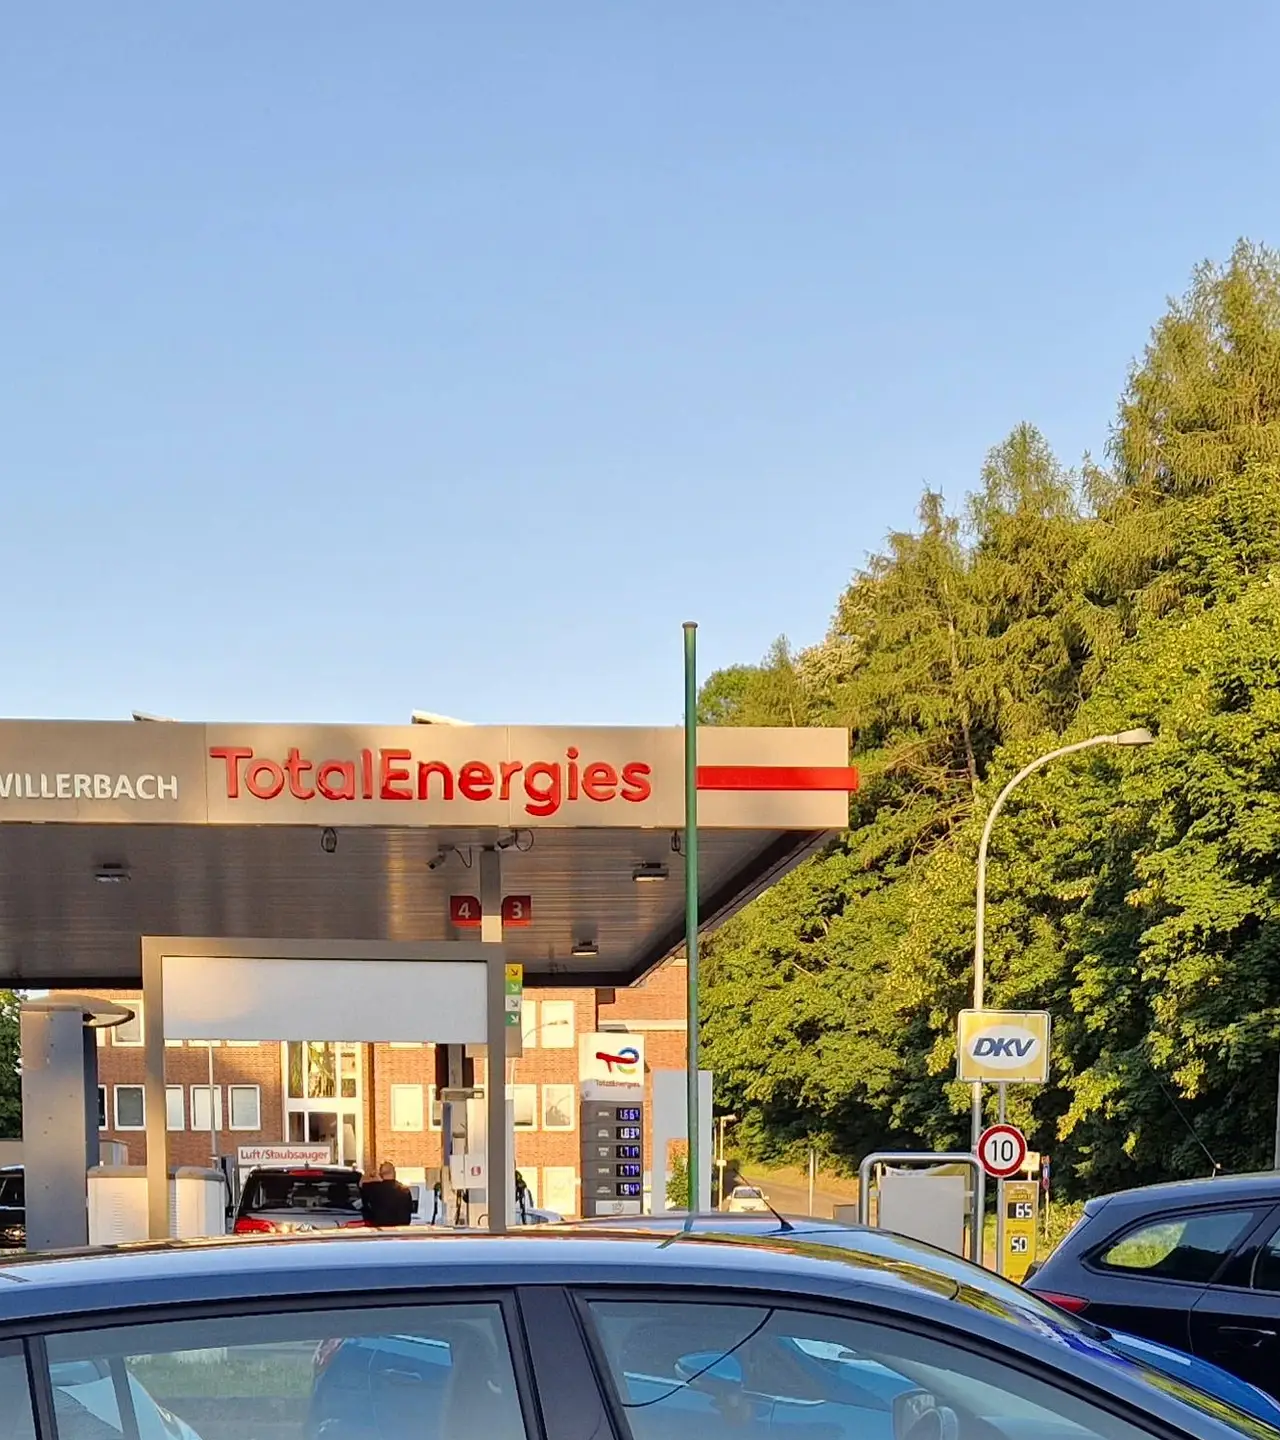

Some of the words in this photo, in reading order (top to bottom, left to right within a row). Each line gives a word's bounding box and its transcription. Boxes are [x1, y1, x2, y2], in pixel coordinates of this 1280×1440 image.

[209, 746, 652, 817] TotalEnergies
[458, 902, 471, 919] 4
[510, 901, 523, 919] 3
[973, 1038, 1036, 1056] DKV
[595, 1079, 641, 1090] TotalEnergies
[240, 1149, 329, 1162] Luft/Staubsauger
[990, 1139, 1014, 1162] 10
[1015, 1202, 1033, 1218] 65
[1011, 1236, 1028, 1253] 50
